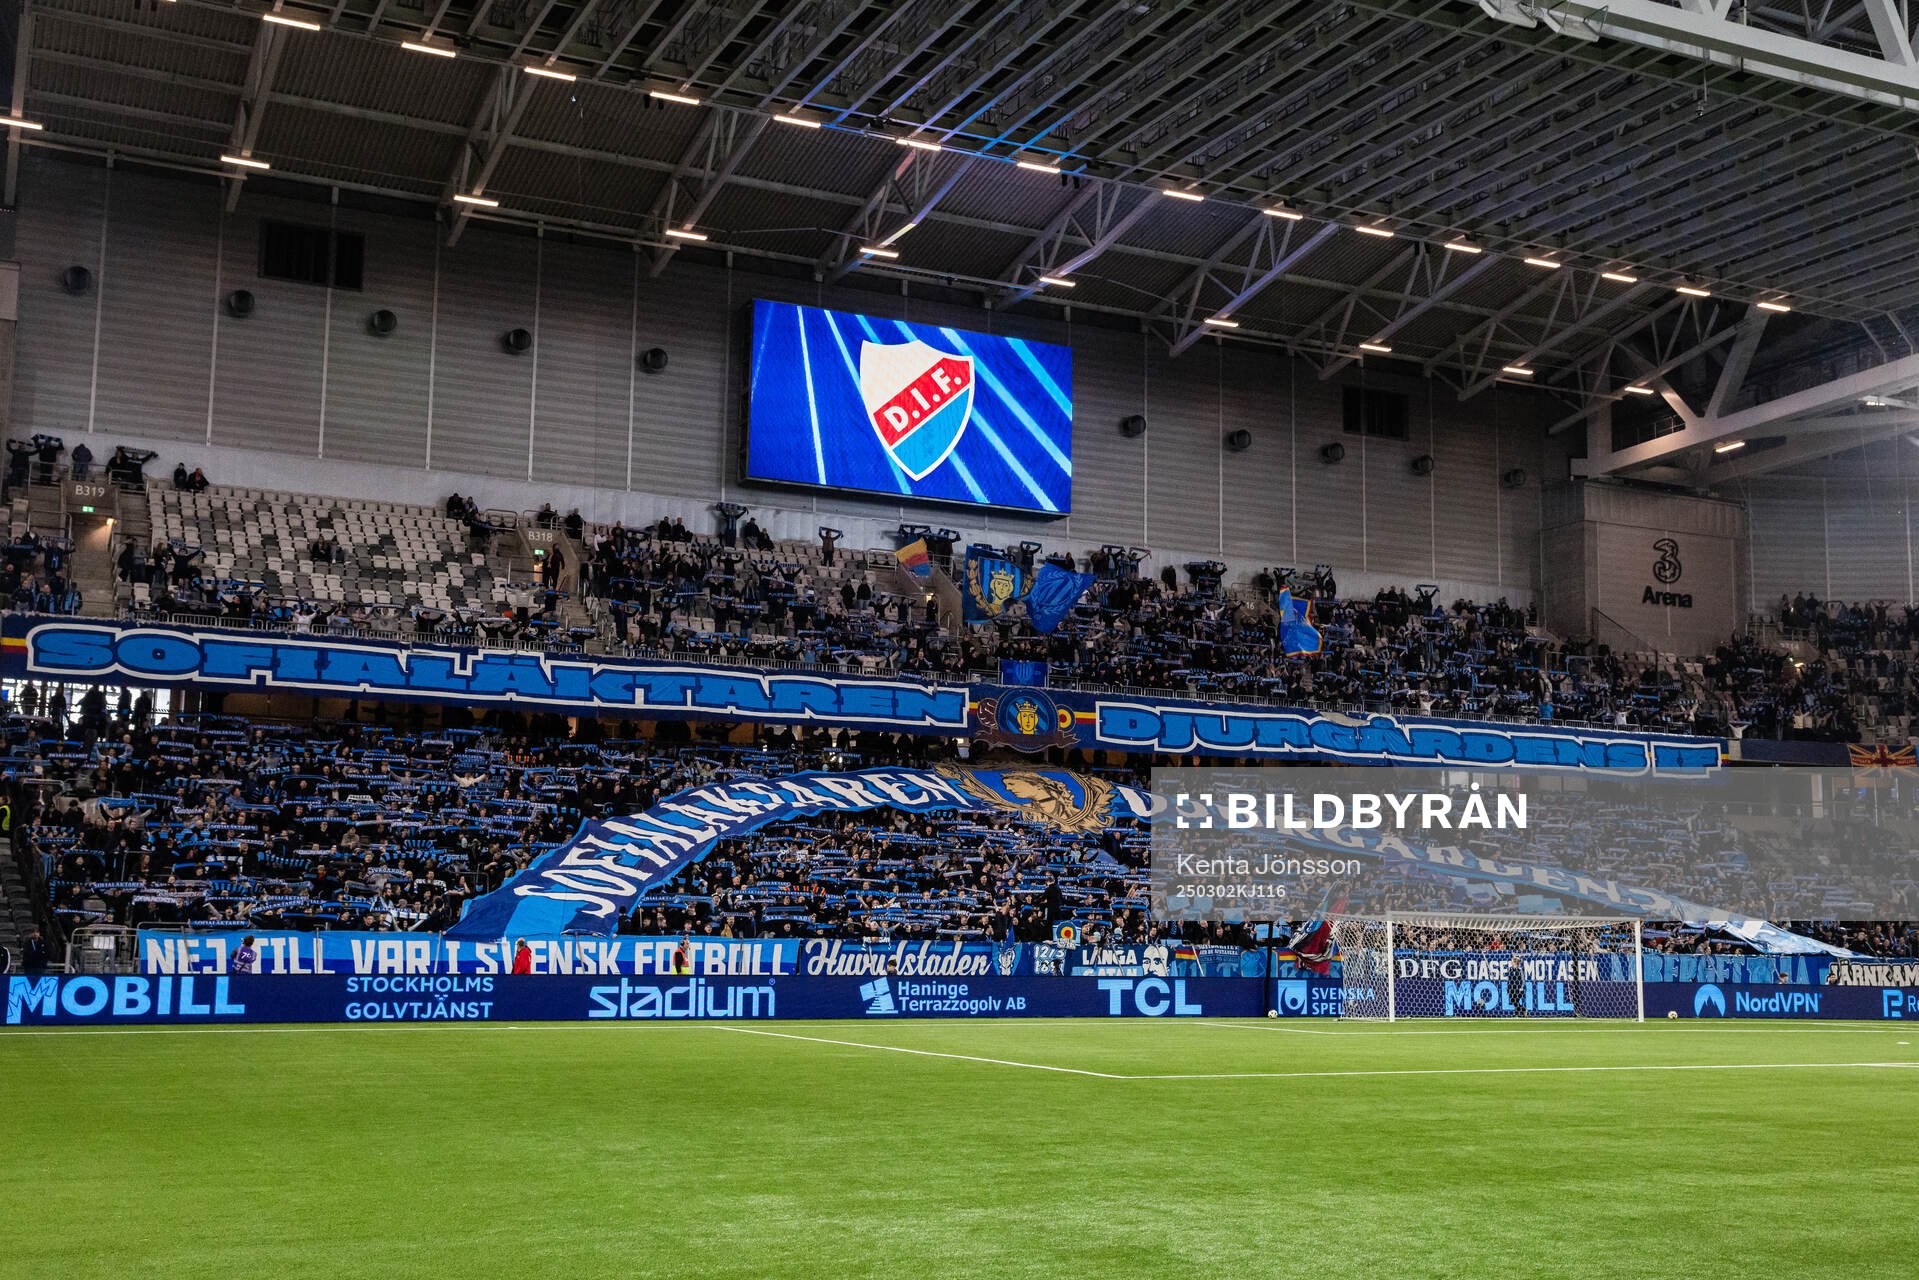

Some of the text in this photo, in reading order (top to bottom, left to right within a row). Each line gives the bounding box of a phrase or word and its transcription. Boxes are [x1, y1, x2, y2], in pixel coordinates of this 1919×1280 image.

[883, 367, 962, 432] D.I.F.
[75, 484, 105, 497] B319
[528, 530, 553, 543] B318
[1642, 586, 1693, 608] Arena
[27, 623, 969, 728] SOFIALÄKTAREN
[1096, 701, 1723, 778] DJURGÅRDENS IF
[146, 937, 227, 974] NEJ
[242, 937, 336, 974] TILL
[351, 939, 431, 974] VAR
[445, 941, 461, 974] I
[634, 942, 790, 975] FOTBOLL
[1399, 959, 1462, 979] DFG
[346, 976, 494, 993] STOCKHOLMS
[898, 980, 969, 999] Haninge
[1311, 987, 1375, 1000] SVENSKA
[6, 975, 245, 1024] MOBILL
[345, 995, 494, 1019] GOLVTJÄNST
[588, 977, 776, 1017] stadium
[899, 996, 1026, 1014] Terrazzogolv AB
[1097, 977, 1202, 1016] TCL
[1735, 991, 1819, 1014] NordVPN
[1311, 1002, 1345, 1015] SPEL
